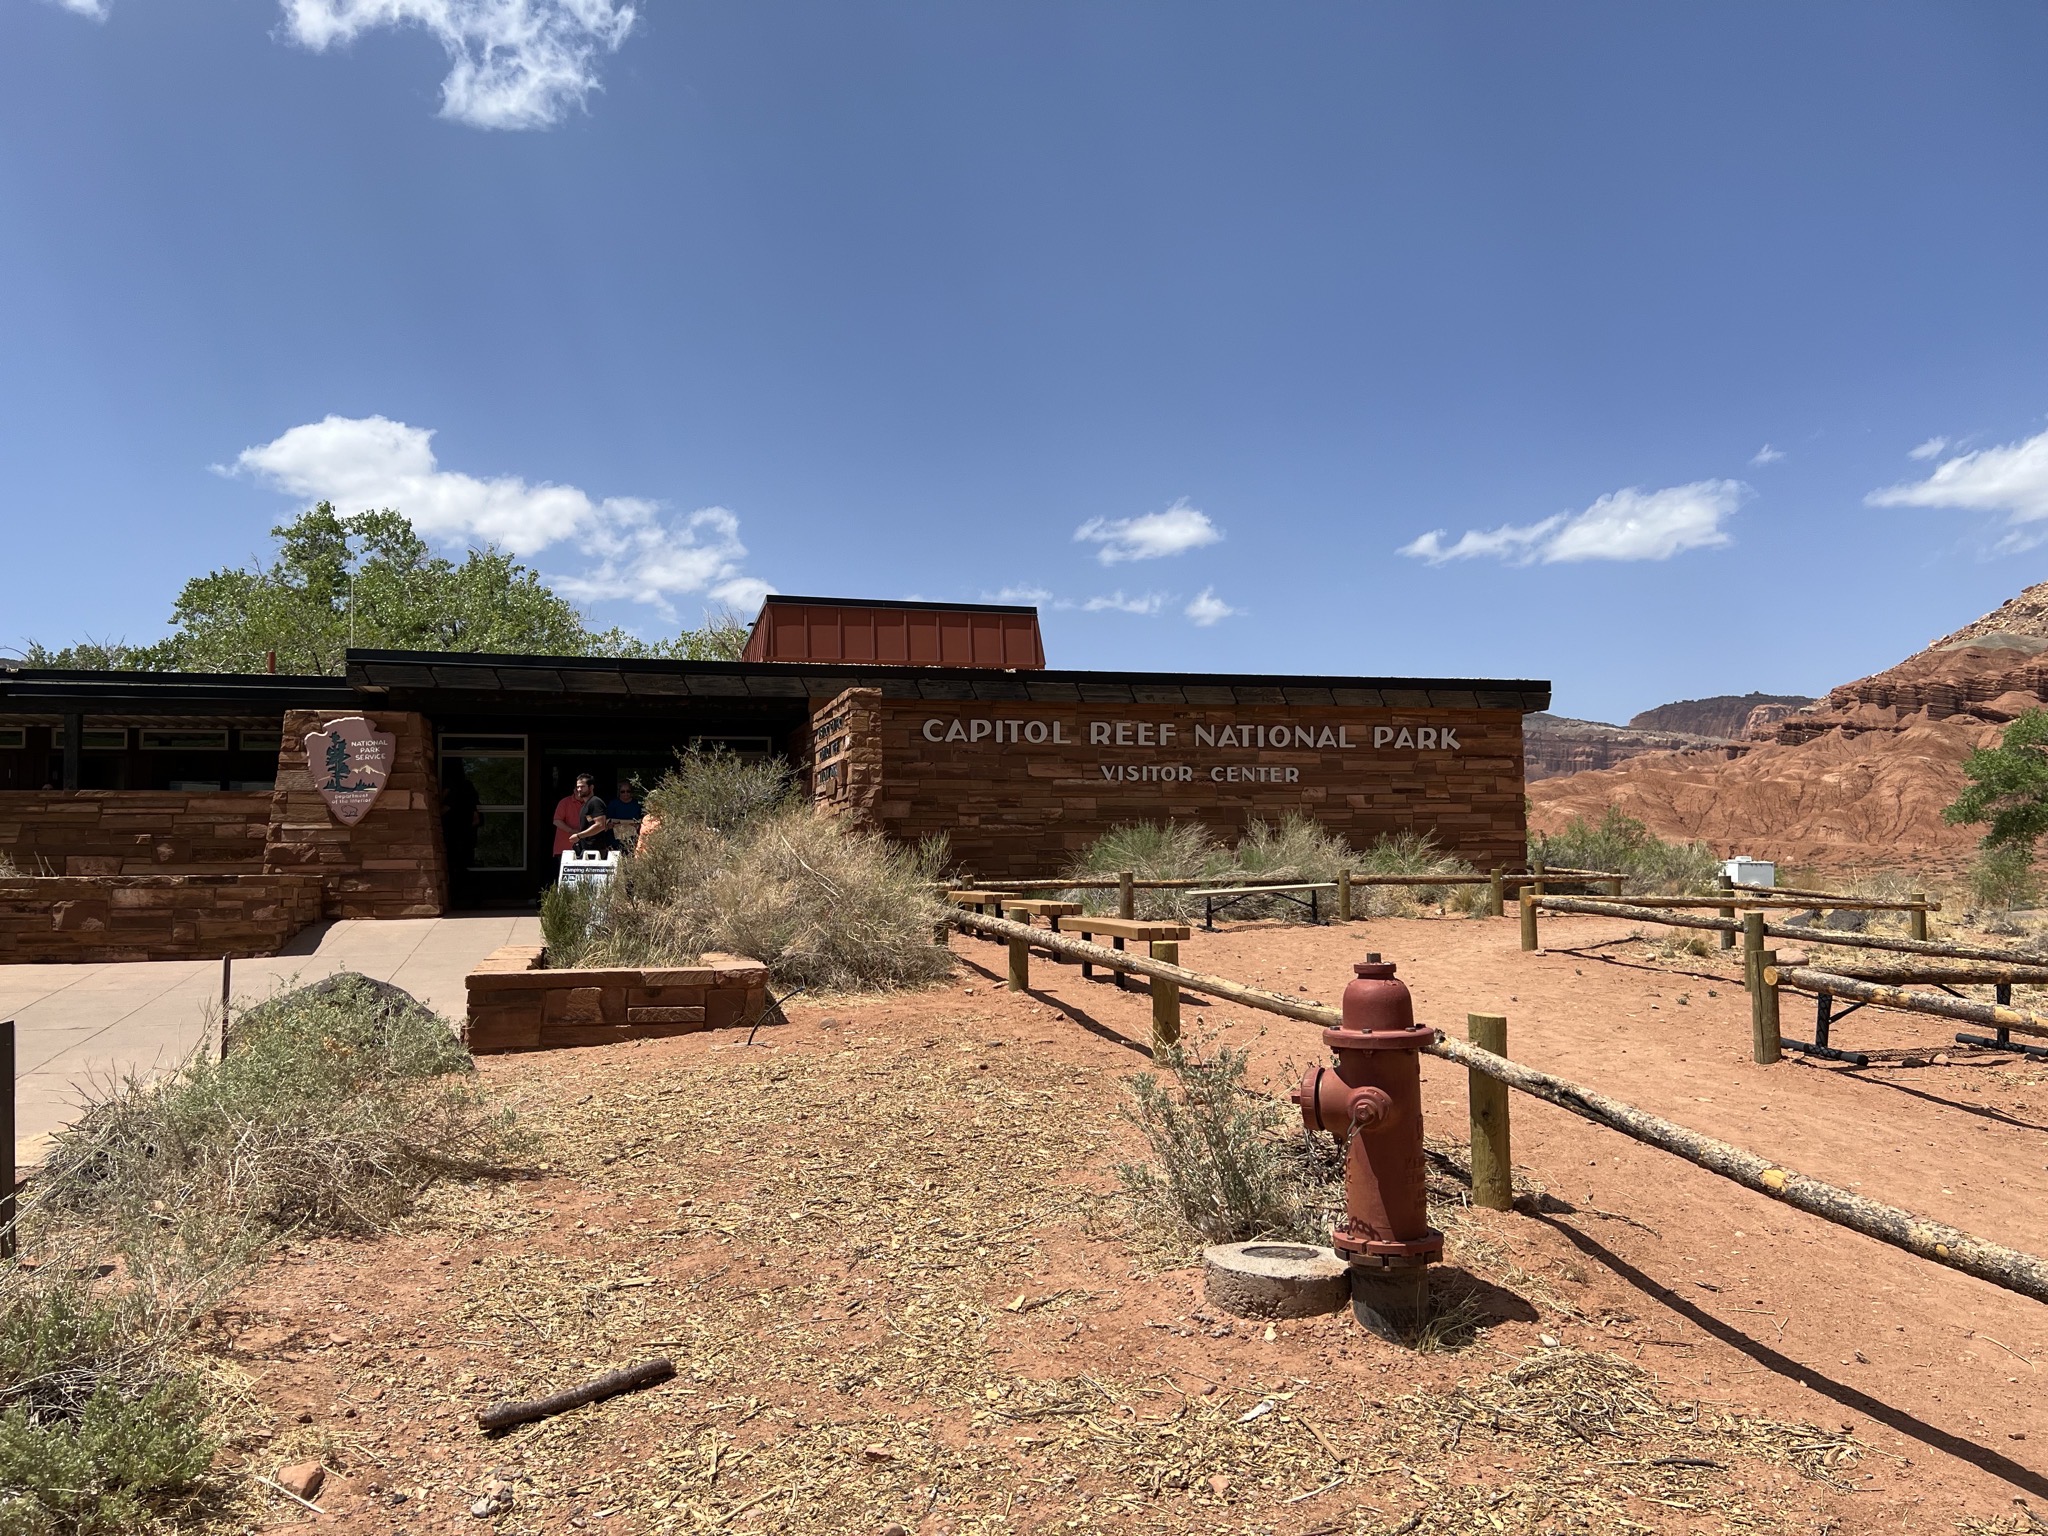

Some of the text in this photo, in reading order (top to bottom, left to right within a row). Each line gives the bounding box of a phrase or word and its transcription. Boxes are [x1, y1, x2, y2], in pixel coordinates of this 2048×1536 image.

[921, 718, 1462, 750] CAPITOL REEF NATIONAL PARK
[1100, 765, 1299, 783] VISITOR CENTER
